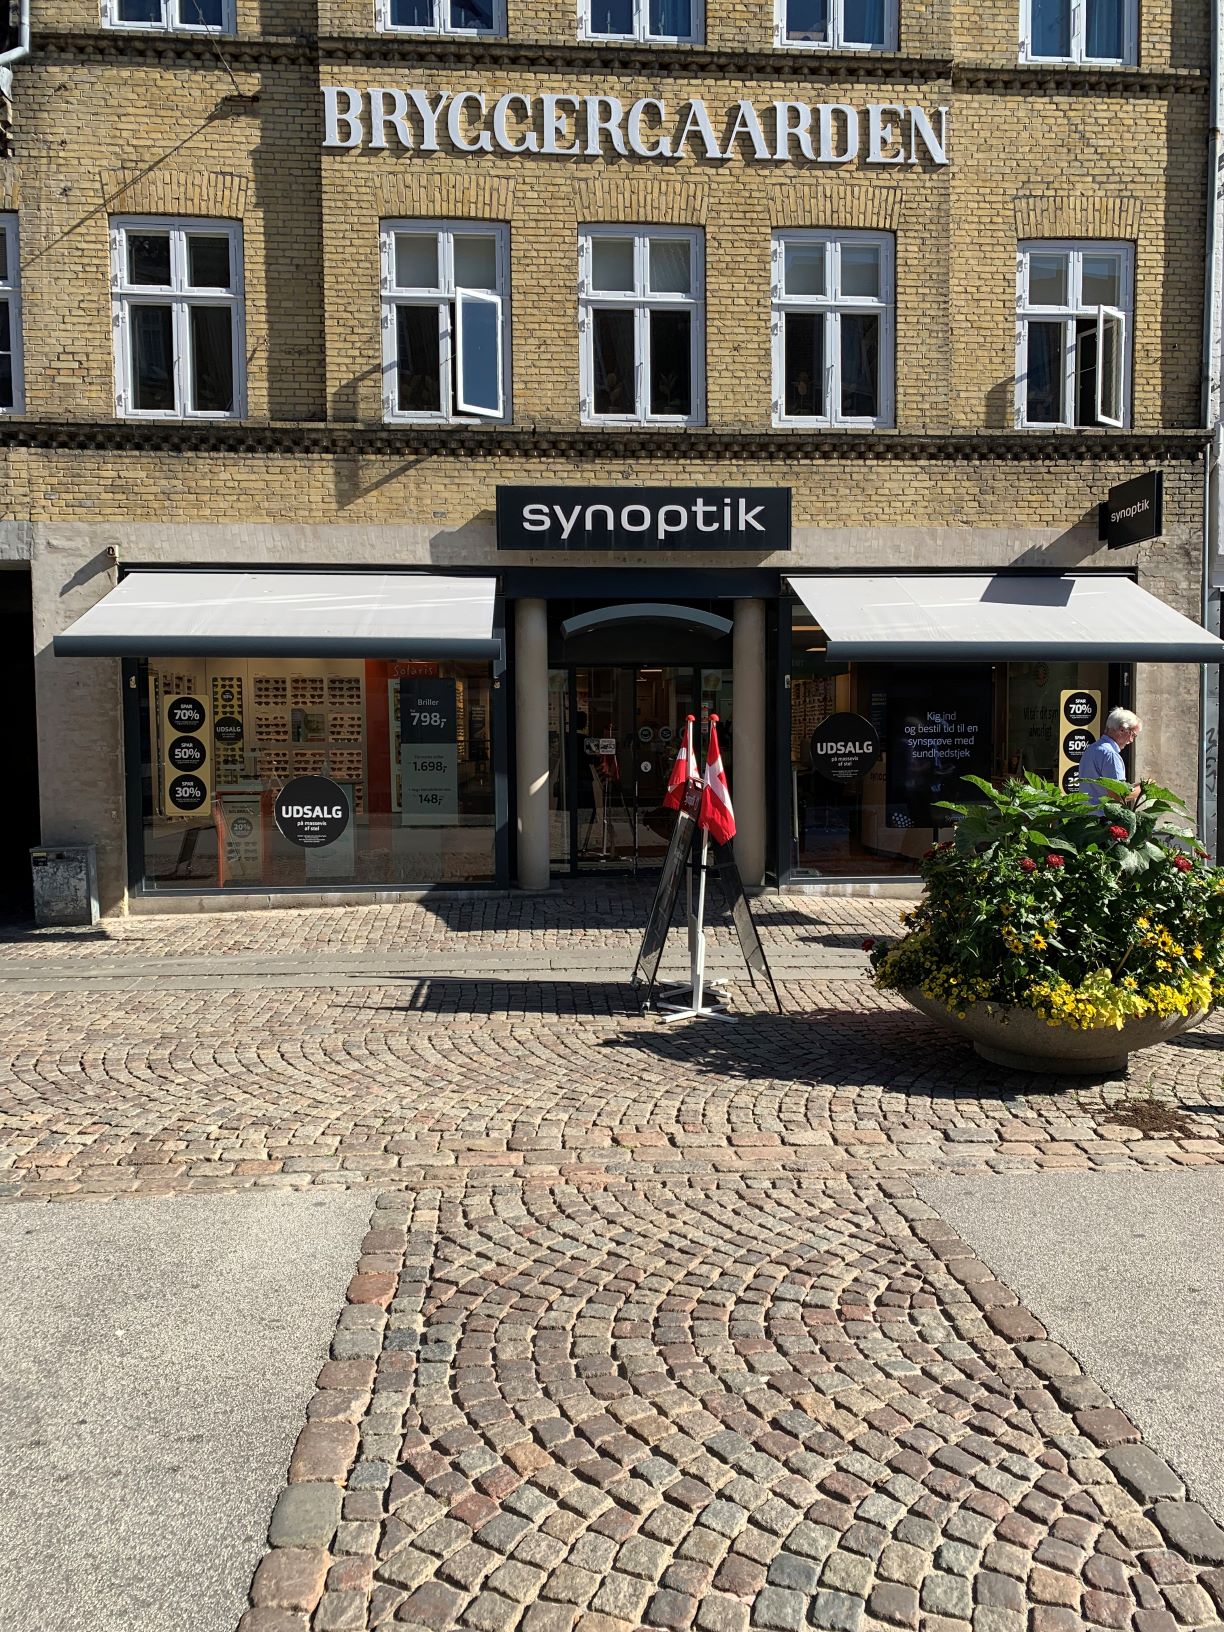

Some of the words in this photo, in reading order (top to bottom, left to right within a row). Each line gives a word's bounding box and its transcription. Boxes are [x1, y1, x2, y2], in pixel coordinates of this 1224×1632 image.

[321, 85, 948, 166] BRYGGERGAARDEN
[1111, 499, 1149, 522] synoptik
[522, 496, 766, 539] synoptik
[174, 709, 199, 720] 70%
[1069, 705, 1092, 714] 70%
[411, 713, 446, 728] 798,-
[927, 712, 941, 722] Kig
[943, 712, 956, 720] ind
[904, 726, 916, 735] og
[918, 724, 941, 733] bestil
[943, 724, 954, 732] tid
[957, 724, 965, 732] til
[908, 738, 952, 747] synsprøve
[954, 737, 974, 745] med
[175, 748, 200, 759] 50%
[817, 742, 872, 754] UDSALG
[912, 749, 970, 759] sundhedstjek
[413, 761, 447, 773] 1.698,-
[175, 787, 201, 797] 30%
[282, 806, 342, 818] UDSALG
